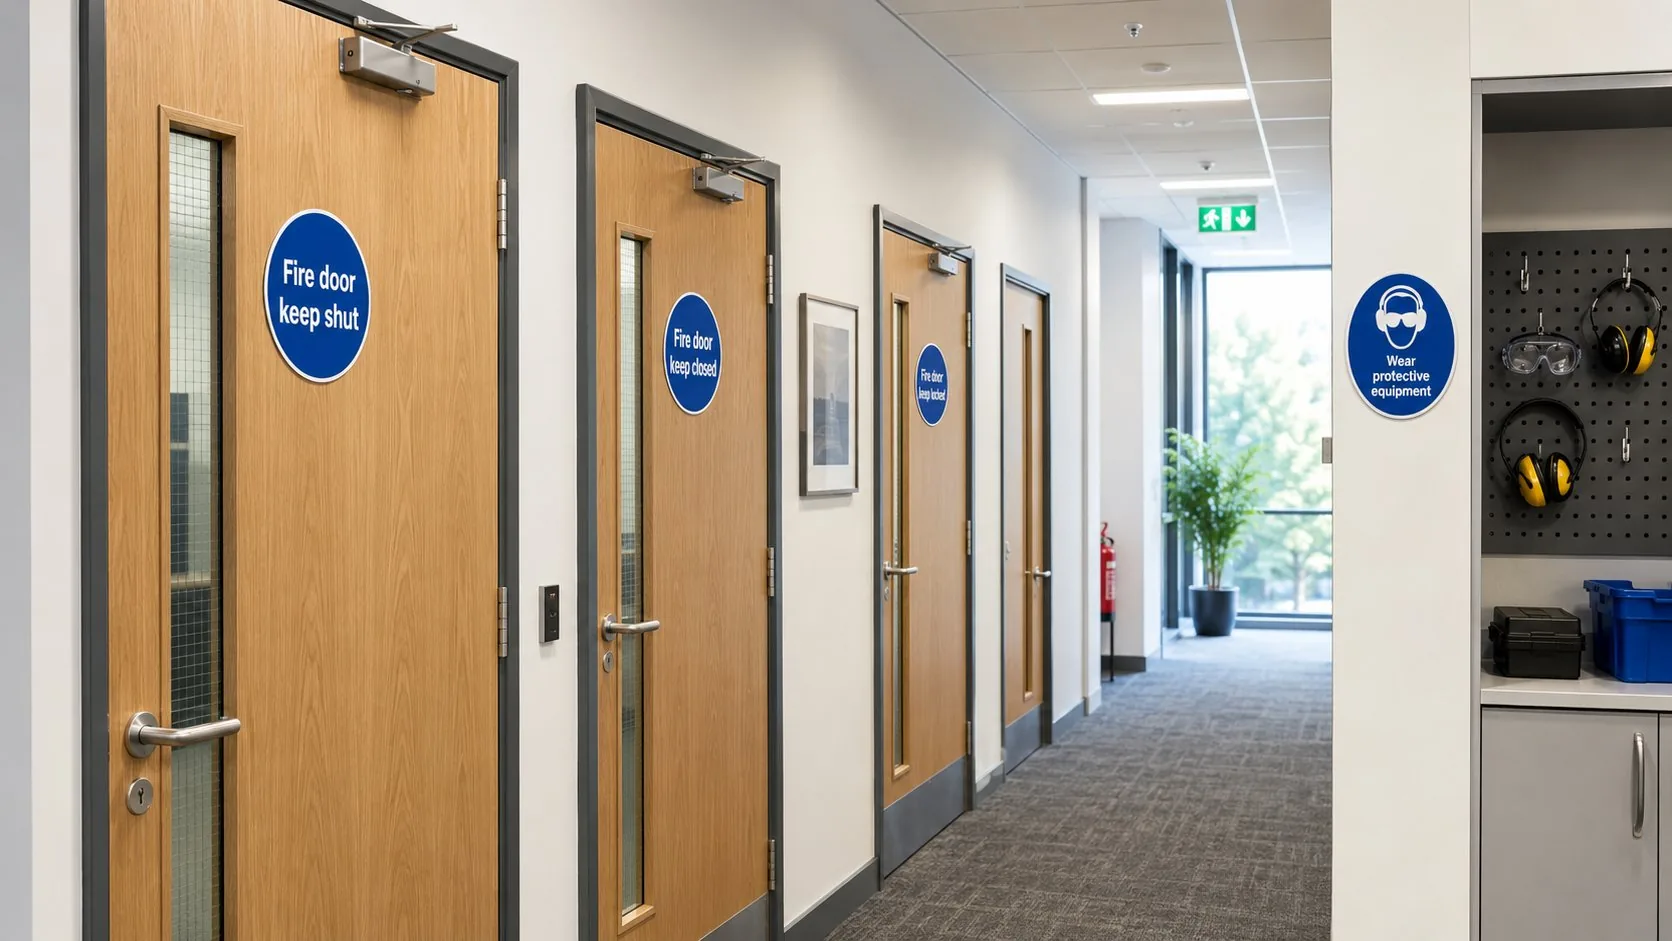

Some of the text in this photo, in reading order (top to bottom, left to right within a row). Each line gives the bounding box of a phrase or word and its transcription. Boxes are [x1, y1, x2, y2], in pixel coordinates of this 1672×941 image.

[283, 258, 357, 293] Fire door
[279, 296, 360, 333] keep shut
[674, 328, 714, 351] Fire door
[669, 354, 717, 380] keep closed
[1386, 354, 1417, 367] Wear
[920, 368, 931, 382] Fire
[1372, 369, 1430, 384] protective
[1371, 384, 1432, 399] equipment
